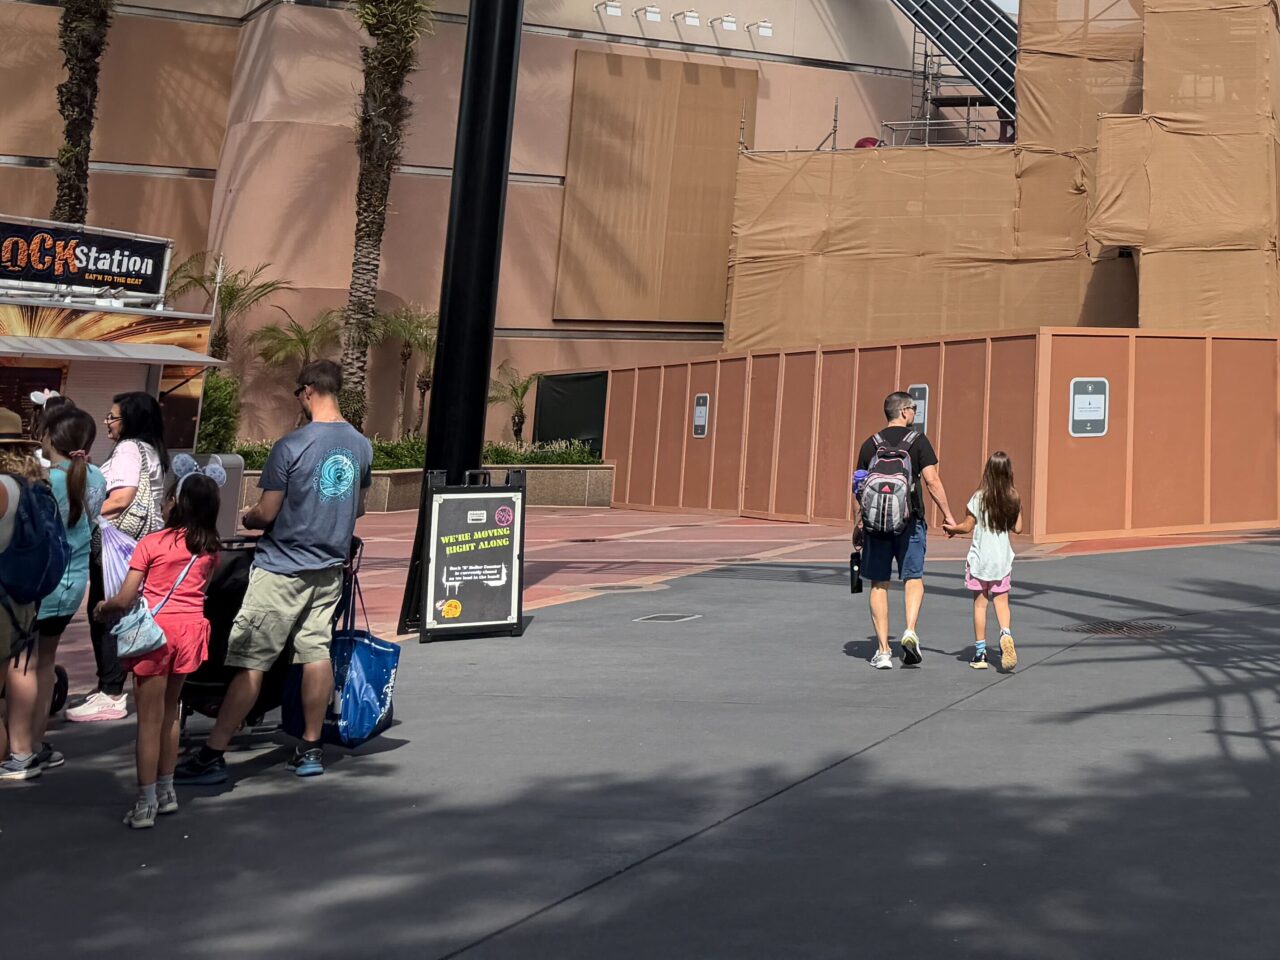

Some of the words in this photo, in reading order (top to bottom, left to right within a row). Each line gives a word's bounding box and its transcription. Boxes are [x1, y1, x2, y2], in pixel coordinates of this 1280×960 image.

[75, 246, 153, 275] Station
[103, 274, 112, 282] TO
[114, 276, 126, 284] THE
[126, 277, 143, 285] BEAT
[440, 533, 471, 544] WE'RE
[473, 527, 510, 540] MOVING
[446, 543, 476, 555] RIGHT
[478, 537, 509, 549] ALONG
